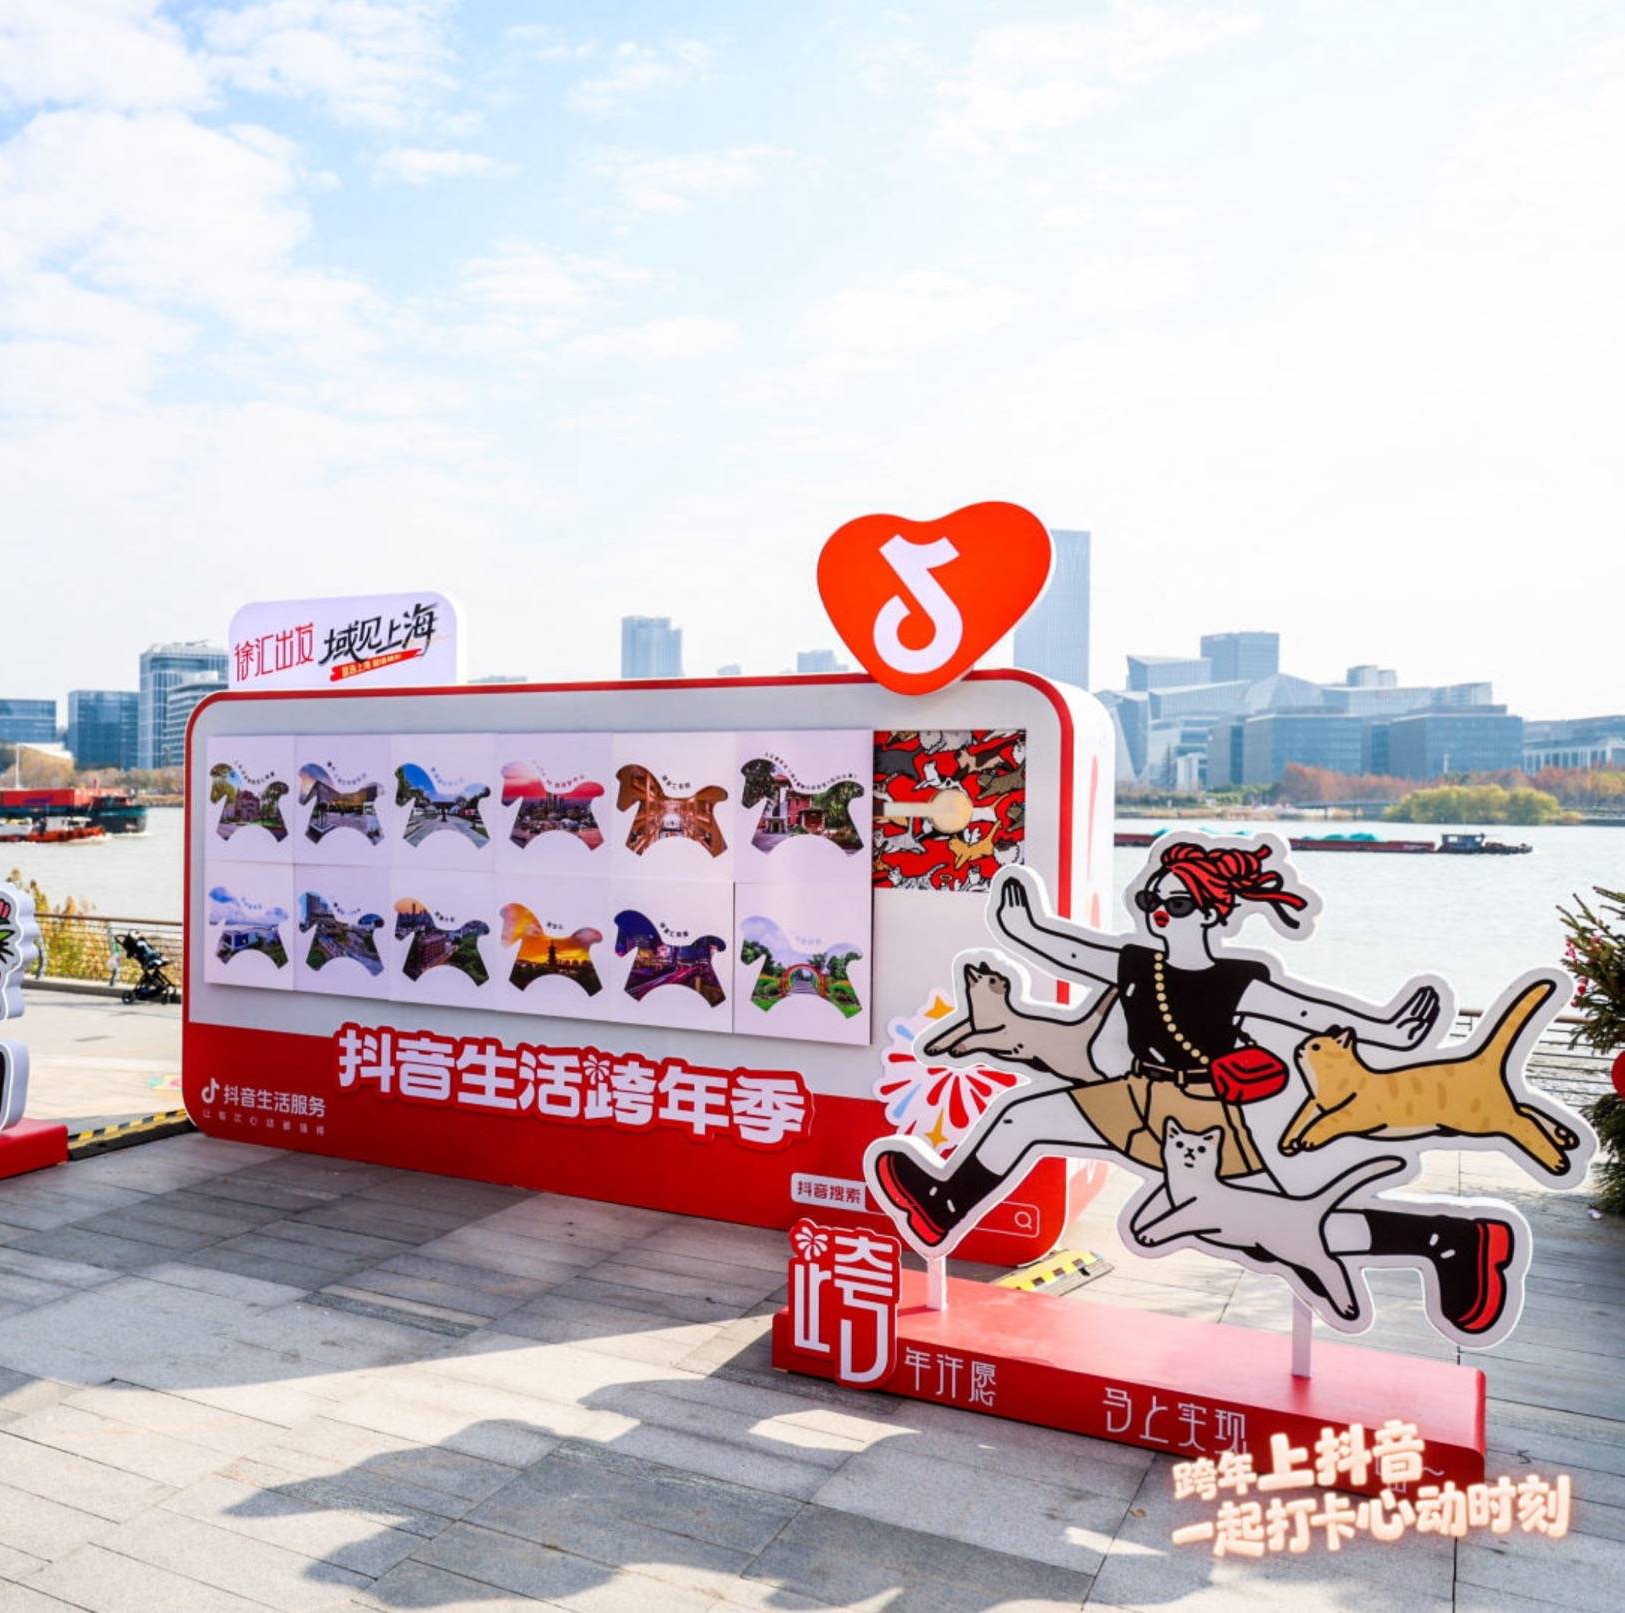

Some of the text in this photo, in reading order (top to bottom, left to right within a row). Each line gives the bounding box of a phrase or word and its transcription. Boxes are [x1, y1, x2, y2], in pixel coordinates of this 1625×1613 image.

[318, 602, 438, 665] 域见上海
[223, 1083, 326, 1118] 抖音生活服务
[339, 1028, 806, 1144] 抖音生活跨年季
[797, 1180, 861, 1205] 抖音搜索
